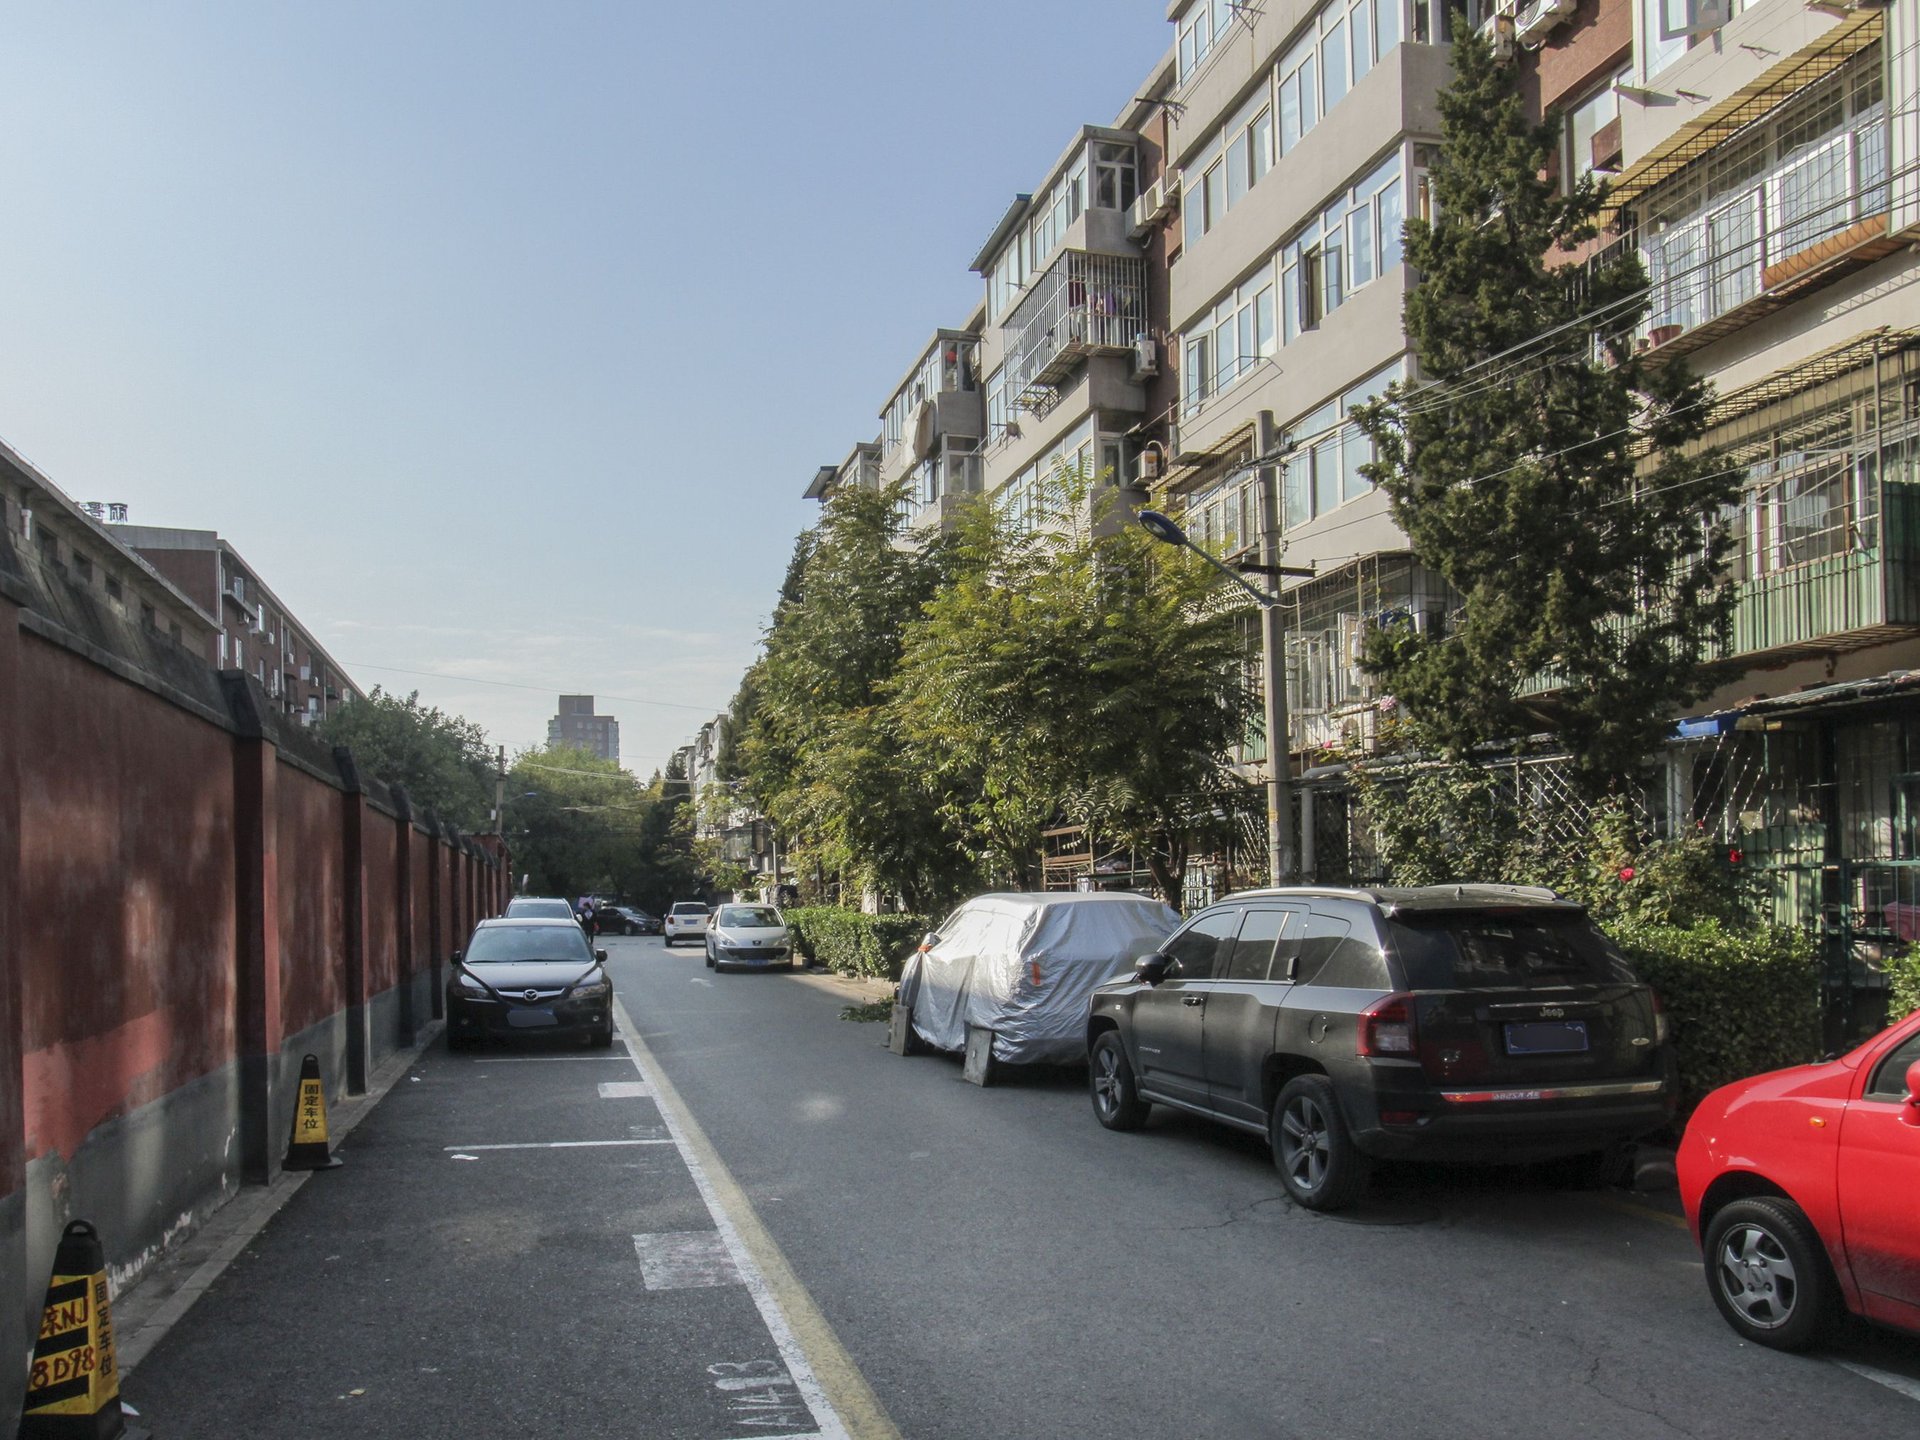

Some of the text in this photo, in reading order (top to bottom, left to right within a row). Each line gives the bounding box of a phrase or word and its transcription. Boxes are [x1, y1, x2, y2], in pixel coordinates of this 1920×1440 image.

[1539, 1006, 1565, 1018] Jeep
[303, 1084, 319, 1129] 固定车位
[95, 1280, 113, 1377] 固定车位
